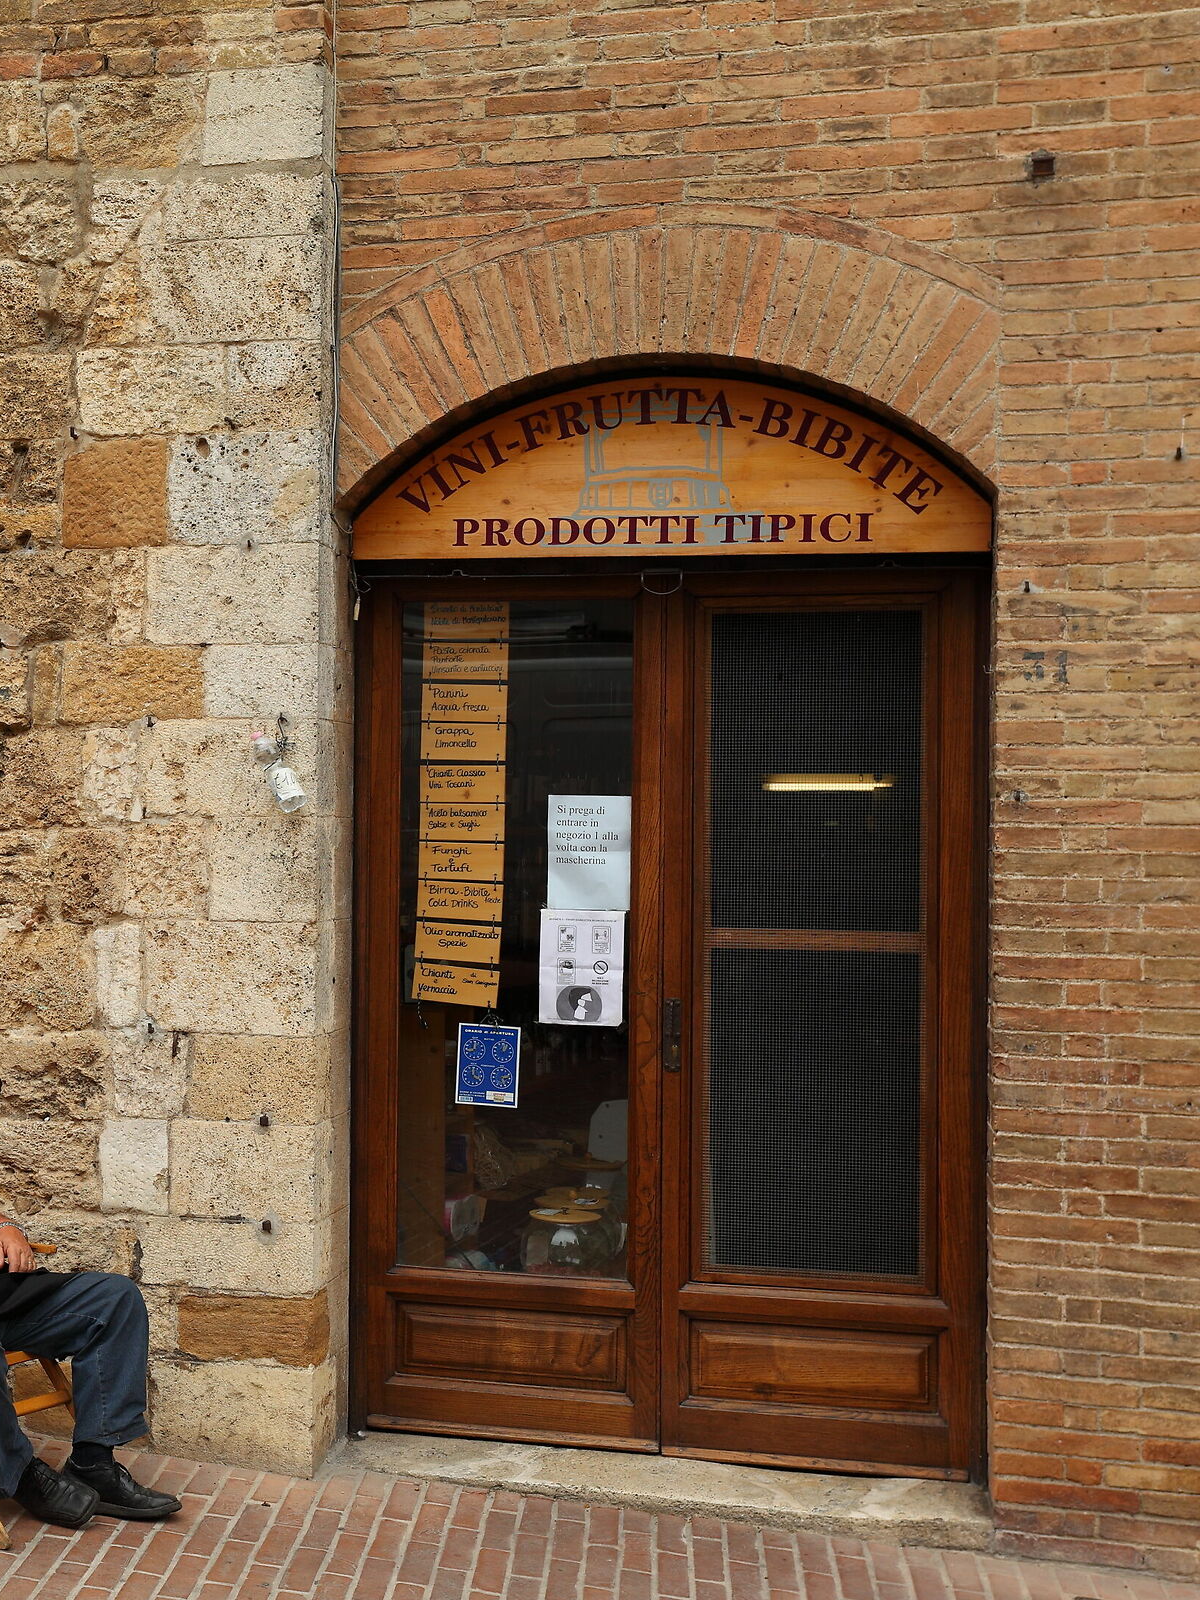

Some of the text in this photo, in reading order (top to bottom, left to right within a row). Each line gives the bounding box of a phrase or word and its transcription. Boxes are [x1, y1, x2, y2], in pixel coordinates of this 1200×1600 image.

[396, 388, 944, 515] VINI-FRUTTA-BIBITE
[452, 513, 874, 547] PRODOTTI TIPICI
[431, 687, 469, 699] Panini
[431, 702, 490, 716] Acqua fresca
[435, 726, 475, 737] Grappa
[435, 739, 478, 748] Limoncello
[446, 779, 476, 789] Toscani
[429, 807, 488, 818] Aceto balsamico
[557, 804, 605, 817] Si prega di
[457, 819, 481, 832] Sughi
[556, 818, 599, 827] entrare in
[556, 830, 592, 841] negozio
[602, 831, 619, 840] alla
[432, 845, 473, 858] Funghi
[556, 843, 578, 852] volta
[599, 843, 608, 852] la
[556, 856, 606, 865] mascherina
[430, 863, 473, 873] Tartufi
[428, 884, 460, 895] Birra
[463, 885, 491, 897] Bibite
[428, 898, 479, 909] Cold Drinks
[424, 926, 443, 935] Olio
[438, 938, 468, 948] Spezie
[421, 968, 456, 979] Chianti
[418, 983, 458, 995] Vernaccia
